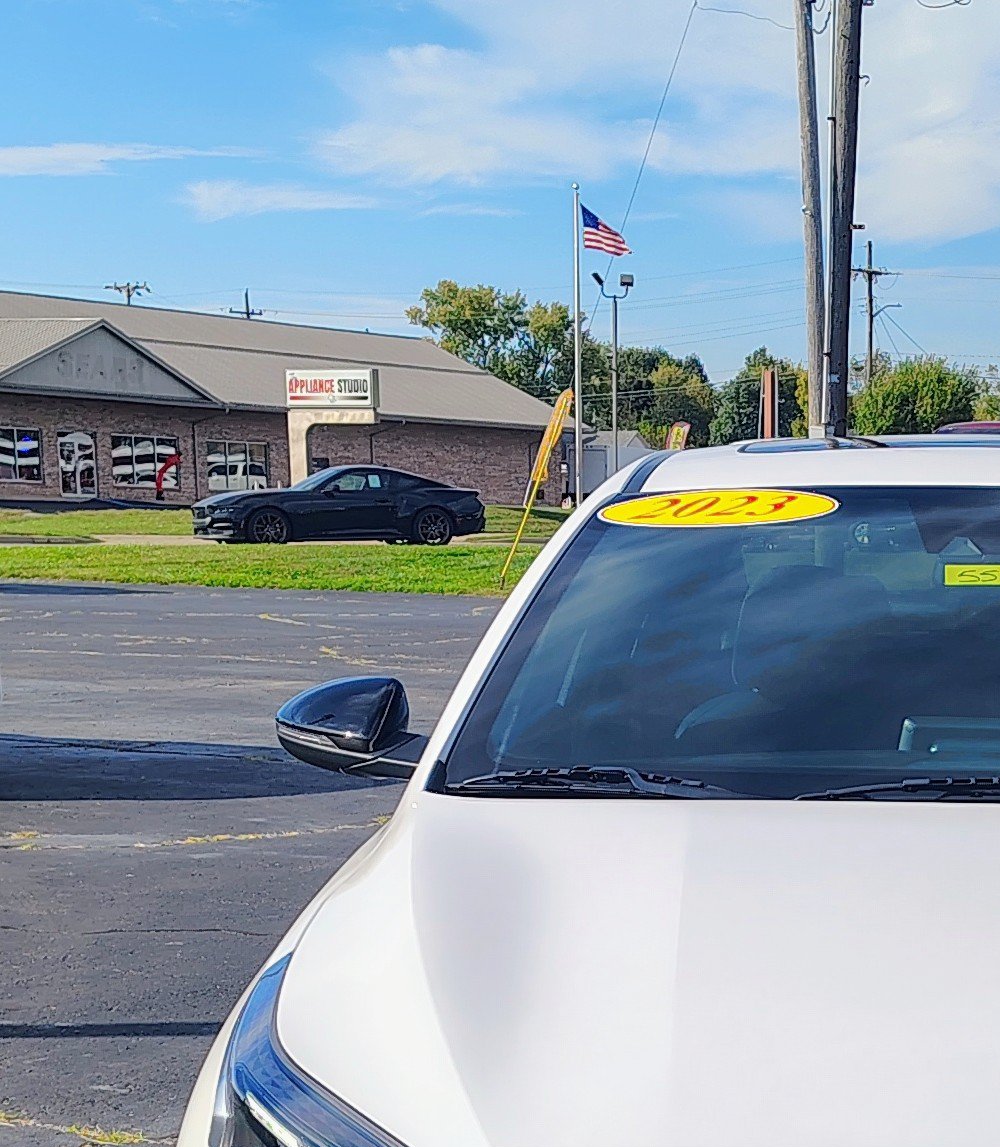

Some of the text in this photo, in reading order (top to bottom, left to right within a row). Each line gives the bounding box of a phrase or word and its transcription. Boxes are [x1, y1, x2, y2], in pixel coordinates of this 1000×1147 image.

[288, 378, 368, 394] APPLIANCE STUDIO
[627, 495, 799, 520] 2023
